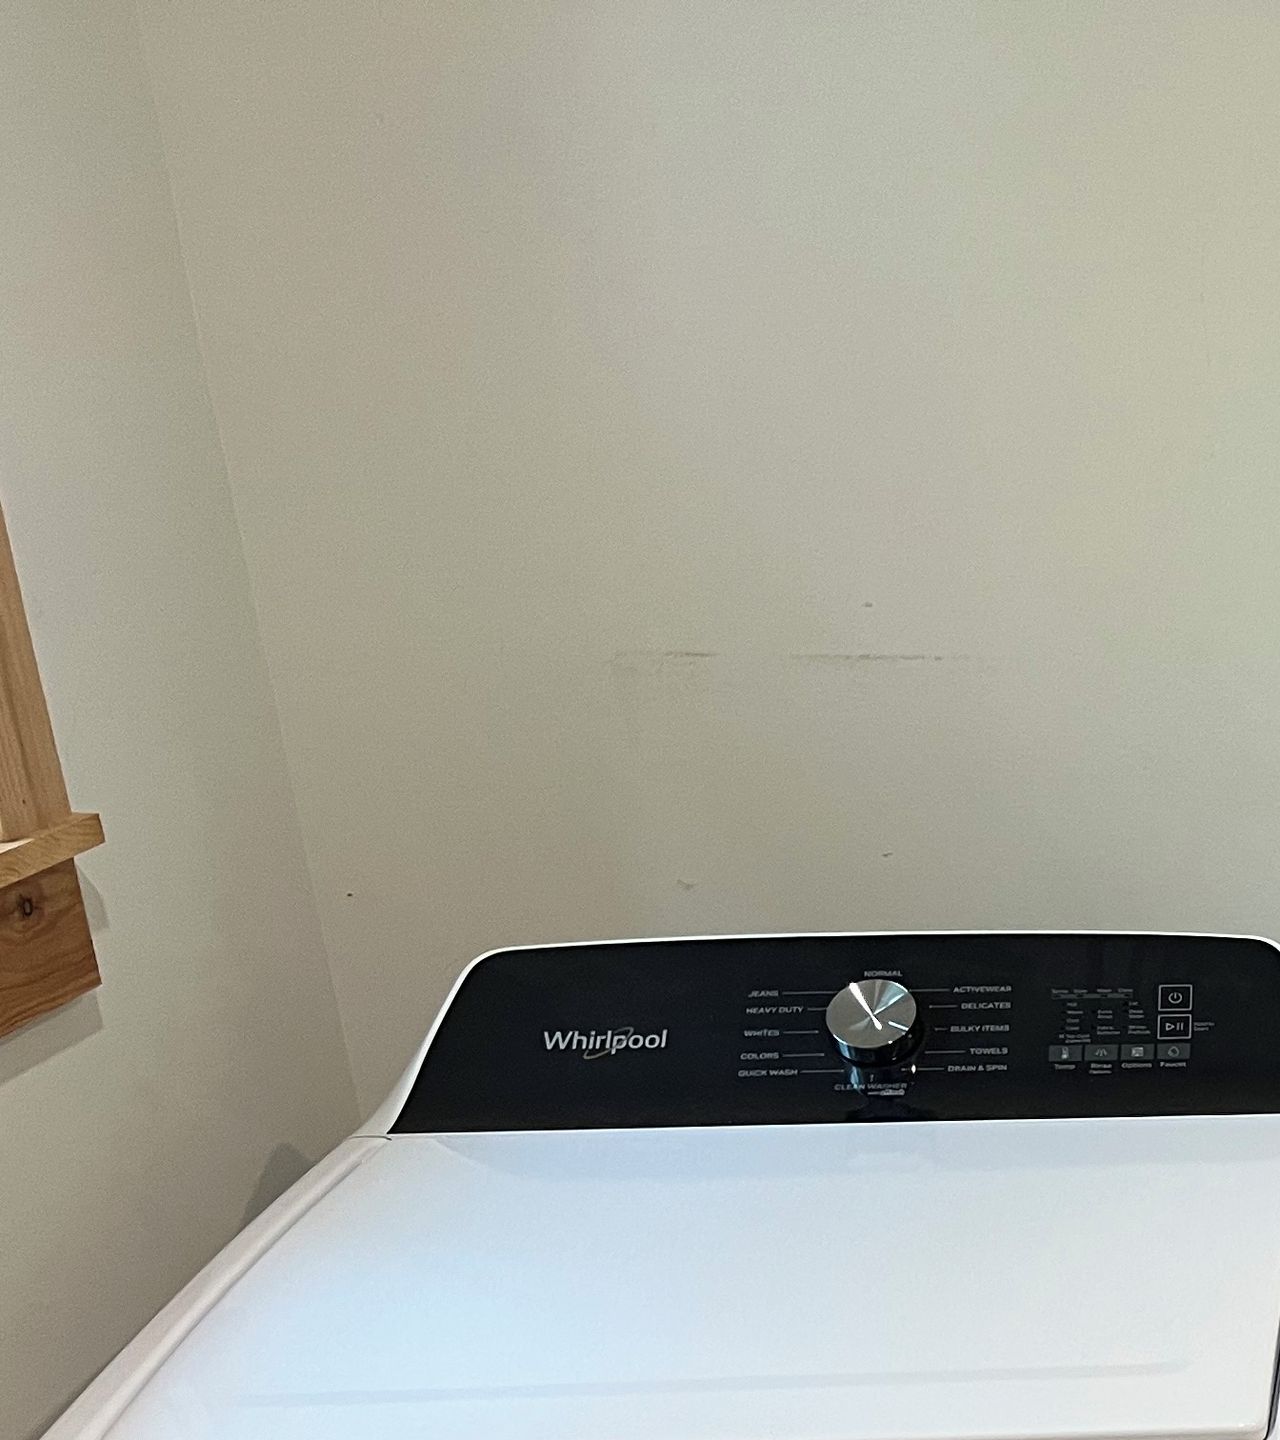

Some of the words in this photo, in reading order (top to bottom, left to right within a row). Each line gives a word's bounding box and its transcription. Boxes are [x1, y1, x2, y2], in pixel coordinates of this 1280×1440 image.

[953, 985, 1012, 993] ACTIVEWEAR
[748, 990, 779, 998] JEANS
[961, 1002, 1011, 1010] DELICATES
[950, 1025, 980, 1033] BULKY
[981, 1024, 1010, 1032] ITEMS
[743, 1029, 780, 1037] WHITES
[543, 1028, 668, 1056] Whirlpool
[970, 1047, 1008, 1055] TOWELS
[740, 1052, 780, 1060] COLORS
[738, 1069, 767, 1077] QUICK
[769, 1068, 798, 1076] WASH
